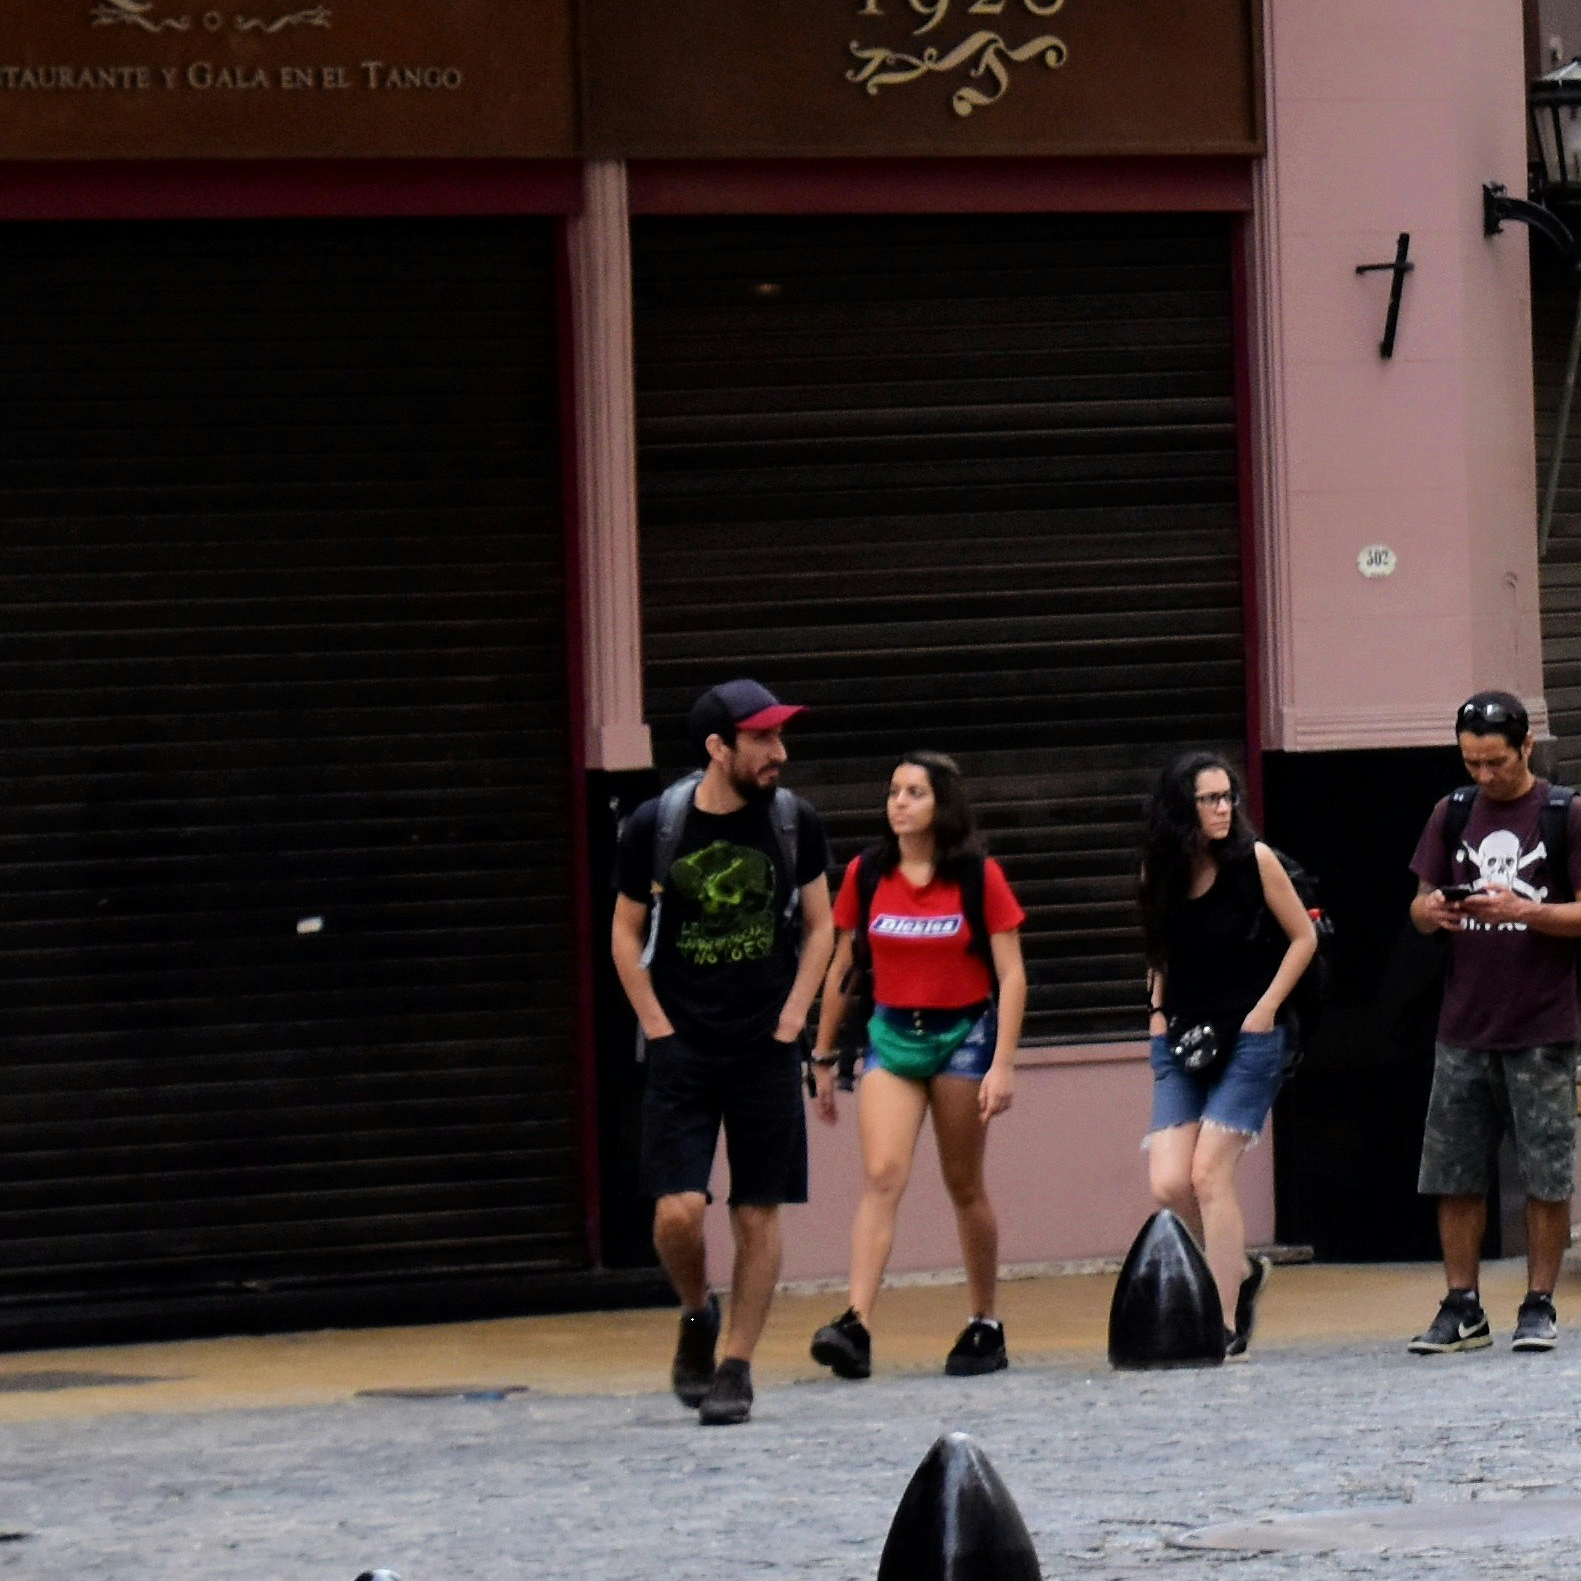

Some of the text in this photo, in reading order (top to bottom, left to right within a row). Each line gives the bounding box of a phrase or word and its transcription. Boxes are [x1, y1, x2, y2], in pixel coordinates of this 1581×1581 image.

[0, 66, 151, 91] TAURANTE
[280, 67, 315, 91] EN
[322, 68, 350, 91] EL
